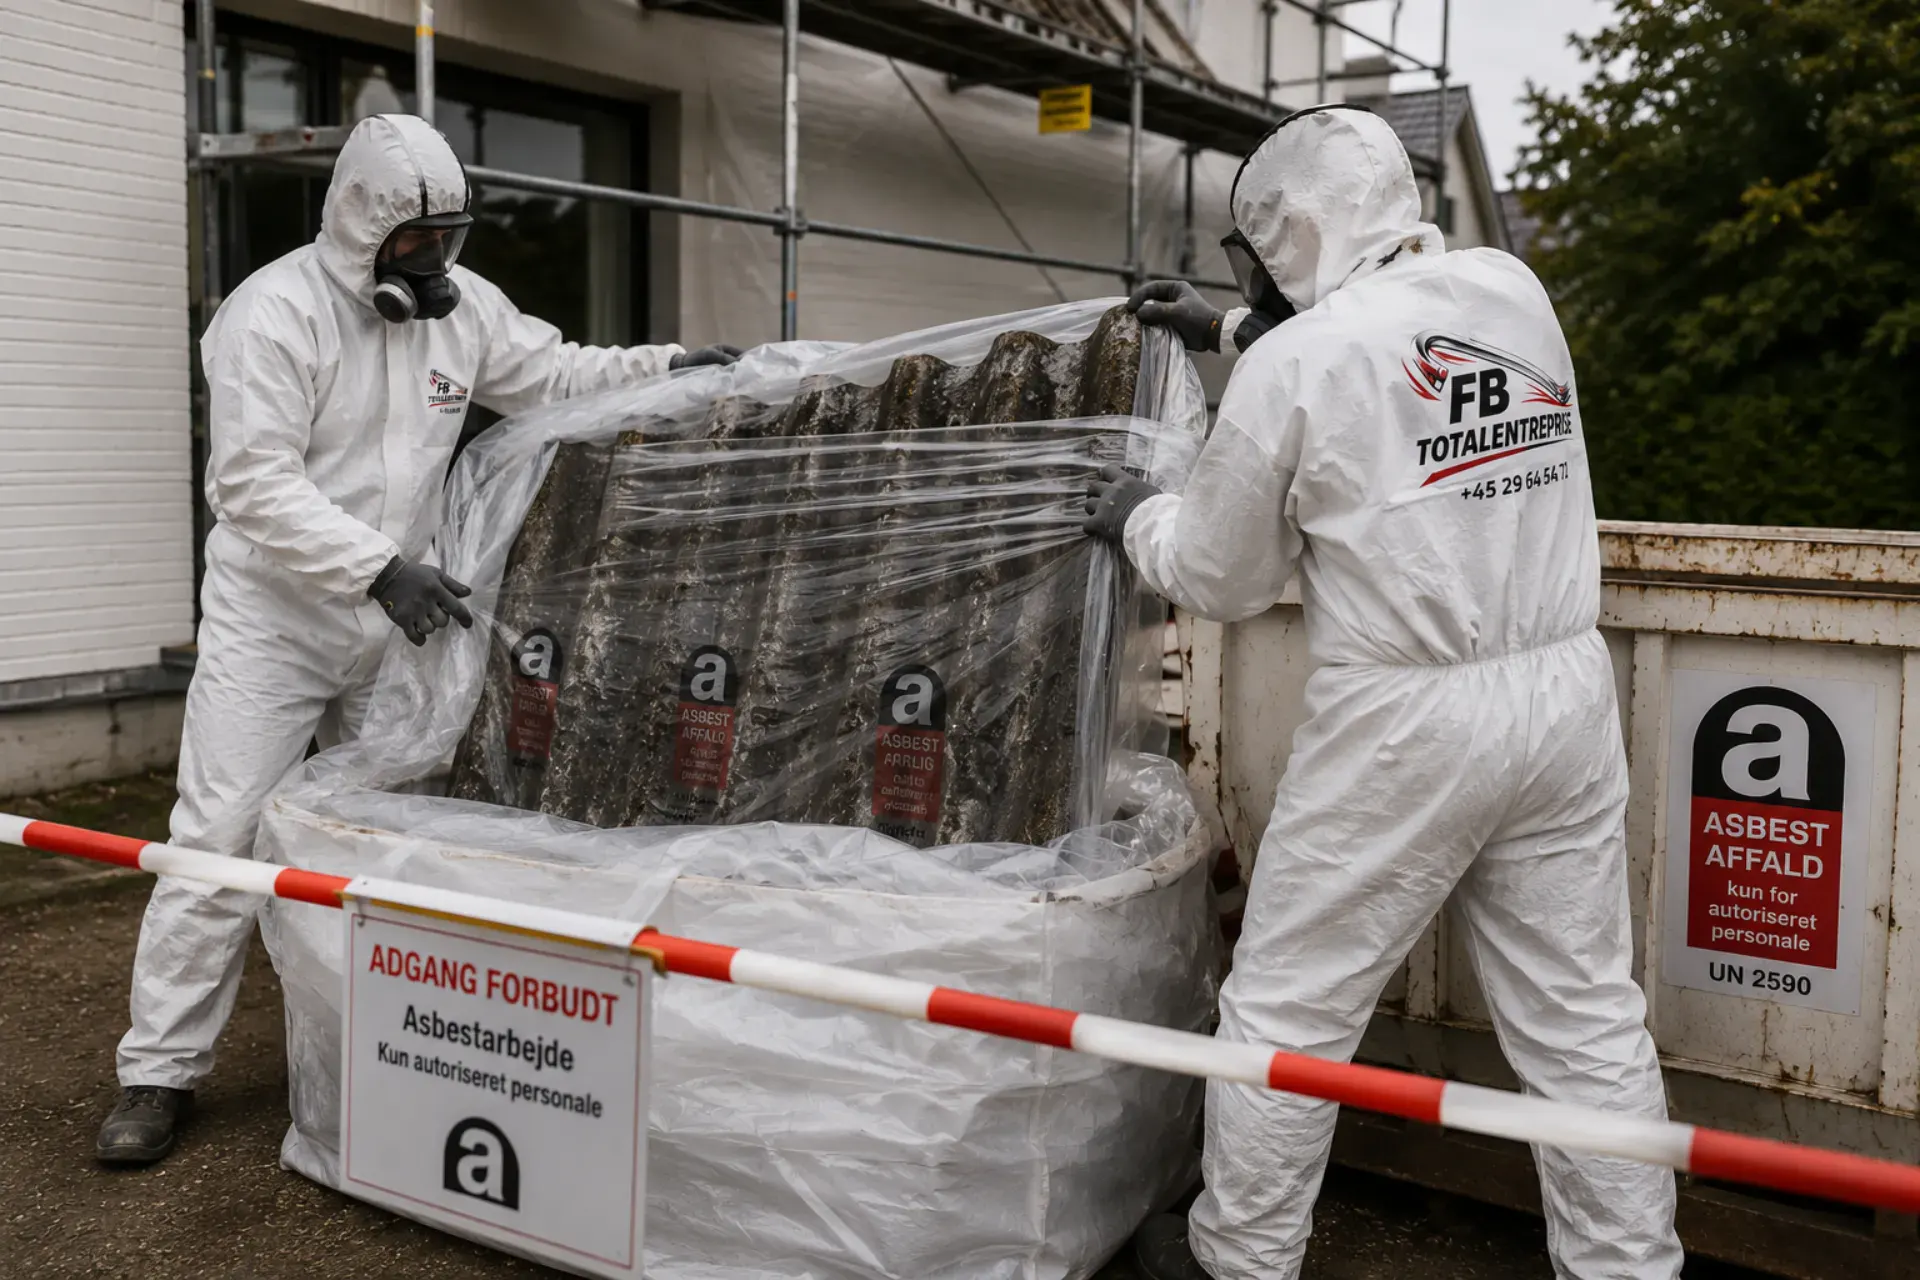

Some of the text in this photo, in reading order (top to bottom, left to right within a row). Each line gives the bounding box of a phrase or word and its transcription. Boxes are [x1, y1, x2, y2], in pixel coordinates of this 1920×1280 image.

[1450, 368, 1510, 425] FB
[1416, 412, 1572, 466] TOTALENTREPRISE
[1461, 480, 1497, 501] +45
[1502, 475, 1523, 496] 29
[1526, 470, 1541, 490] 64
[1544, 465, 1559, 485] 54
[681, 707, 731, 728] ASBEST
[880, 732, 940, 753] ASBEST
[1703, 811, 1830, 847] ASBEST
[1705, 844, 1824, 879] AFFALD
[1727, 880, 1799, 905] kun for
[1708, 903, 1818, 931] autoriseret
[1711, 925, 1811, 951] personale
[368, 943, 620, 1027] ADGANG FORBUDT
[1709, 961, 1812, 997] UN 2590
[402, 1004, 575, 1072] Asbestarbejde
[377, 1040, 604, 1118] Kun autoriseret personale
